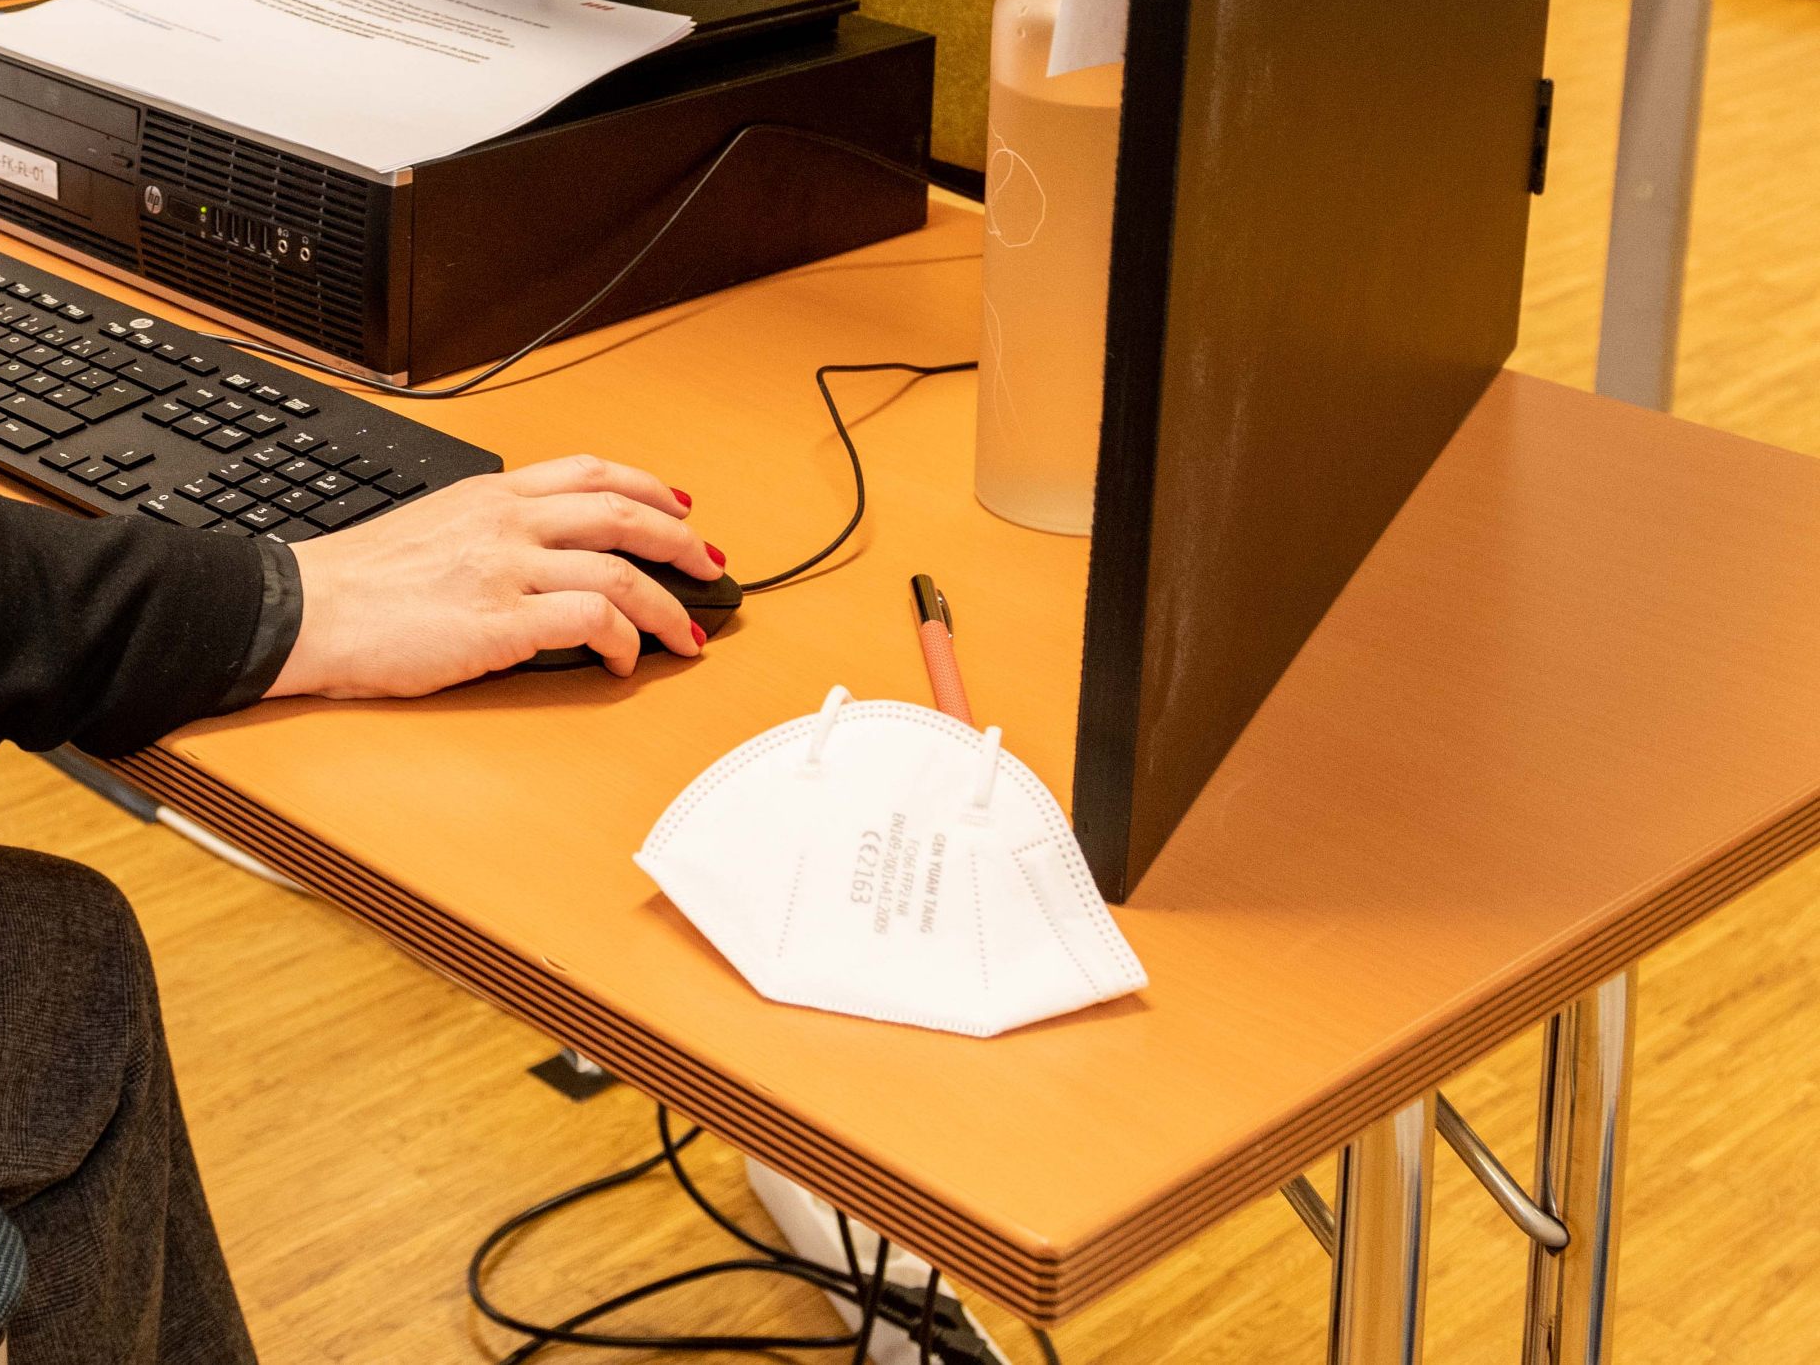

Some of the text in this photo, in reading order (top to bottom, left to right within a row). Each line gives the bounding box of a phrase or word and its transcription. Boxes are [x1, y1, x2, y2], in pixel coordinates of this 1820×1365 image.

[146, 186, 162, 214] hp
[924, 861, 942, 897] YUAN
[919, 899, 938, 935] TANG
